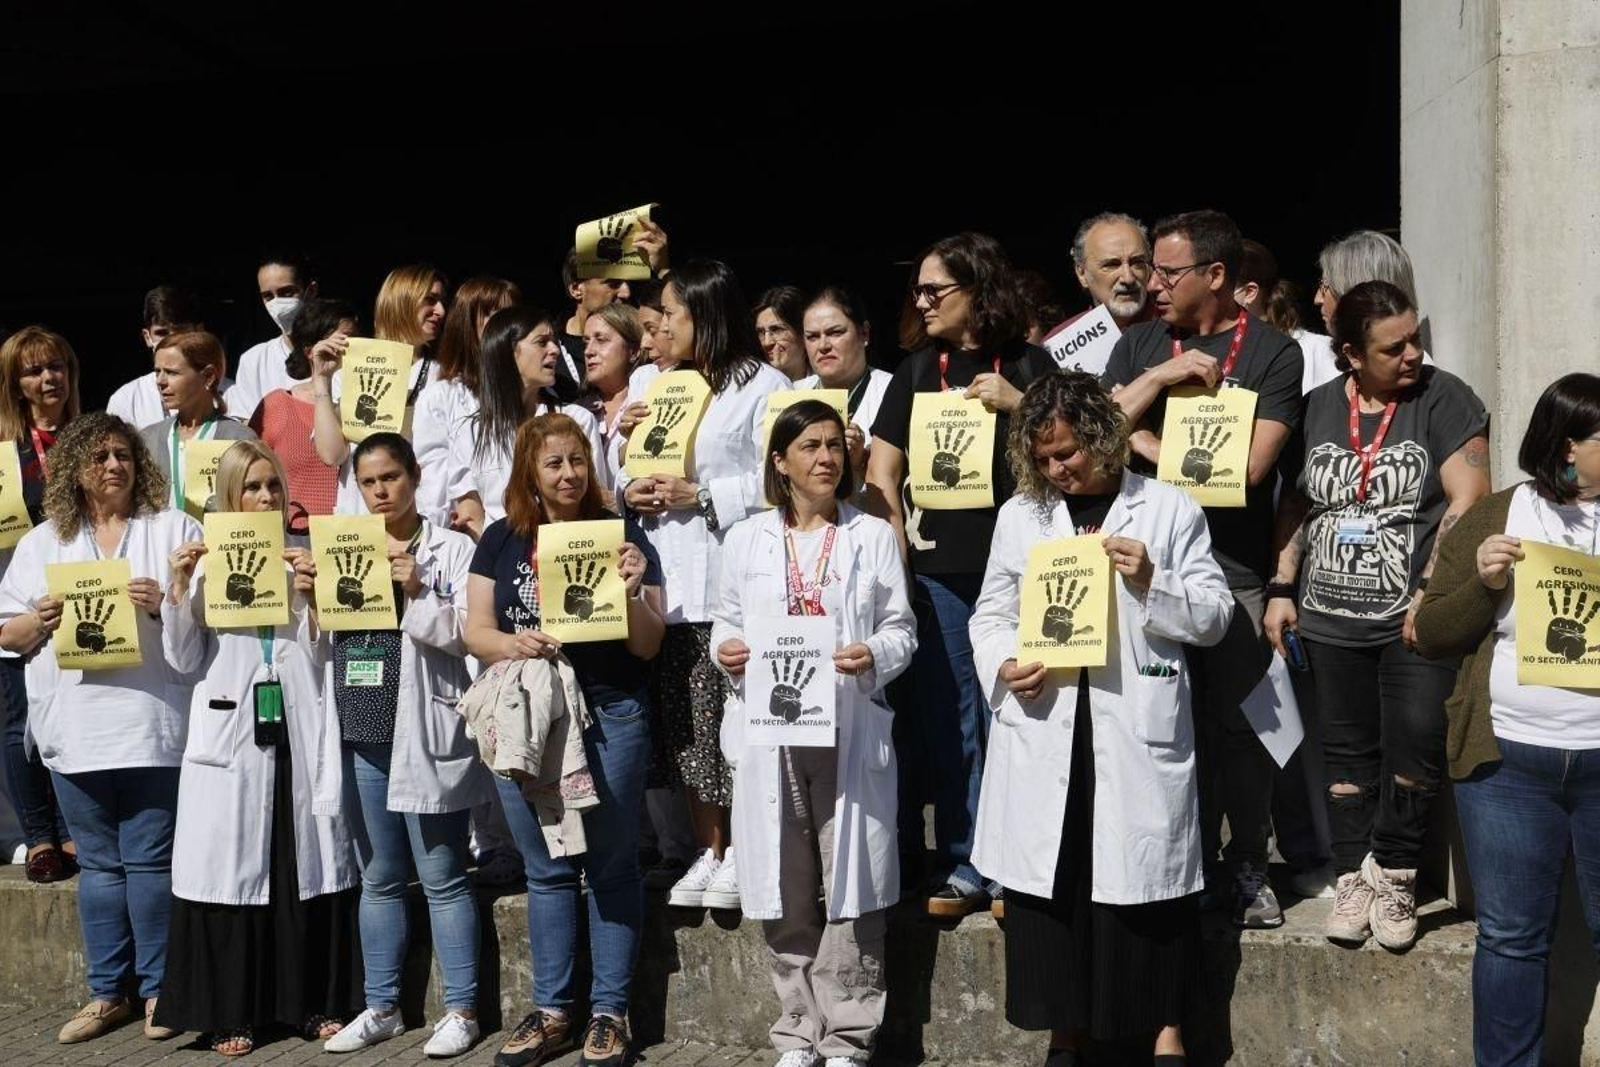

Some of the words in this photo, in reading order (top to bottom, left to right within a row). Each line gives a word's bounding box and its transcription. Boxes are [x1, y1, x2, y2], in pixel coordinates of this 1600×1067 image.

[1054, 321, 1107, 361] UCIÓNS
[666, 386, 686, 394] CERO
[1198, 404, 1225, 413] CERO
[230, 530, 255, 539] CERO
[336, 533, 359, 542] CERO
[568, 540, 595, 549] CERO
[1052, 555, 1078, 567] CERO
[1553, 565, 1582, 578] CERO
[76, 578, 102, 588] CERO
[777, 637, 804, 646] CERO
[1522, 655, 1535, 663] NO
[349, 662, 379, 671] SATSE
